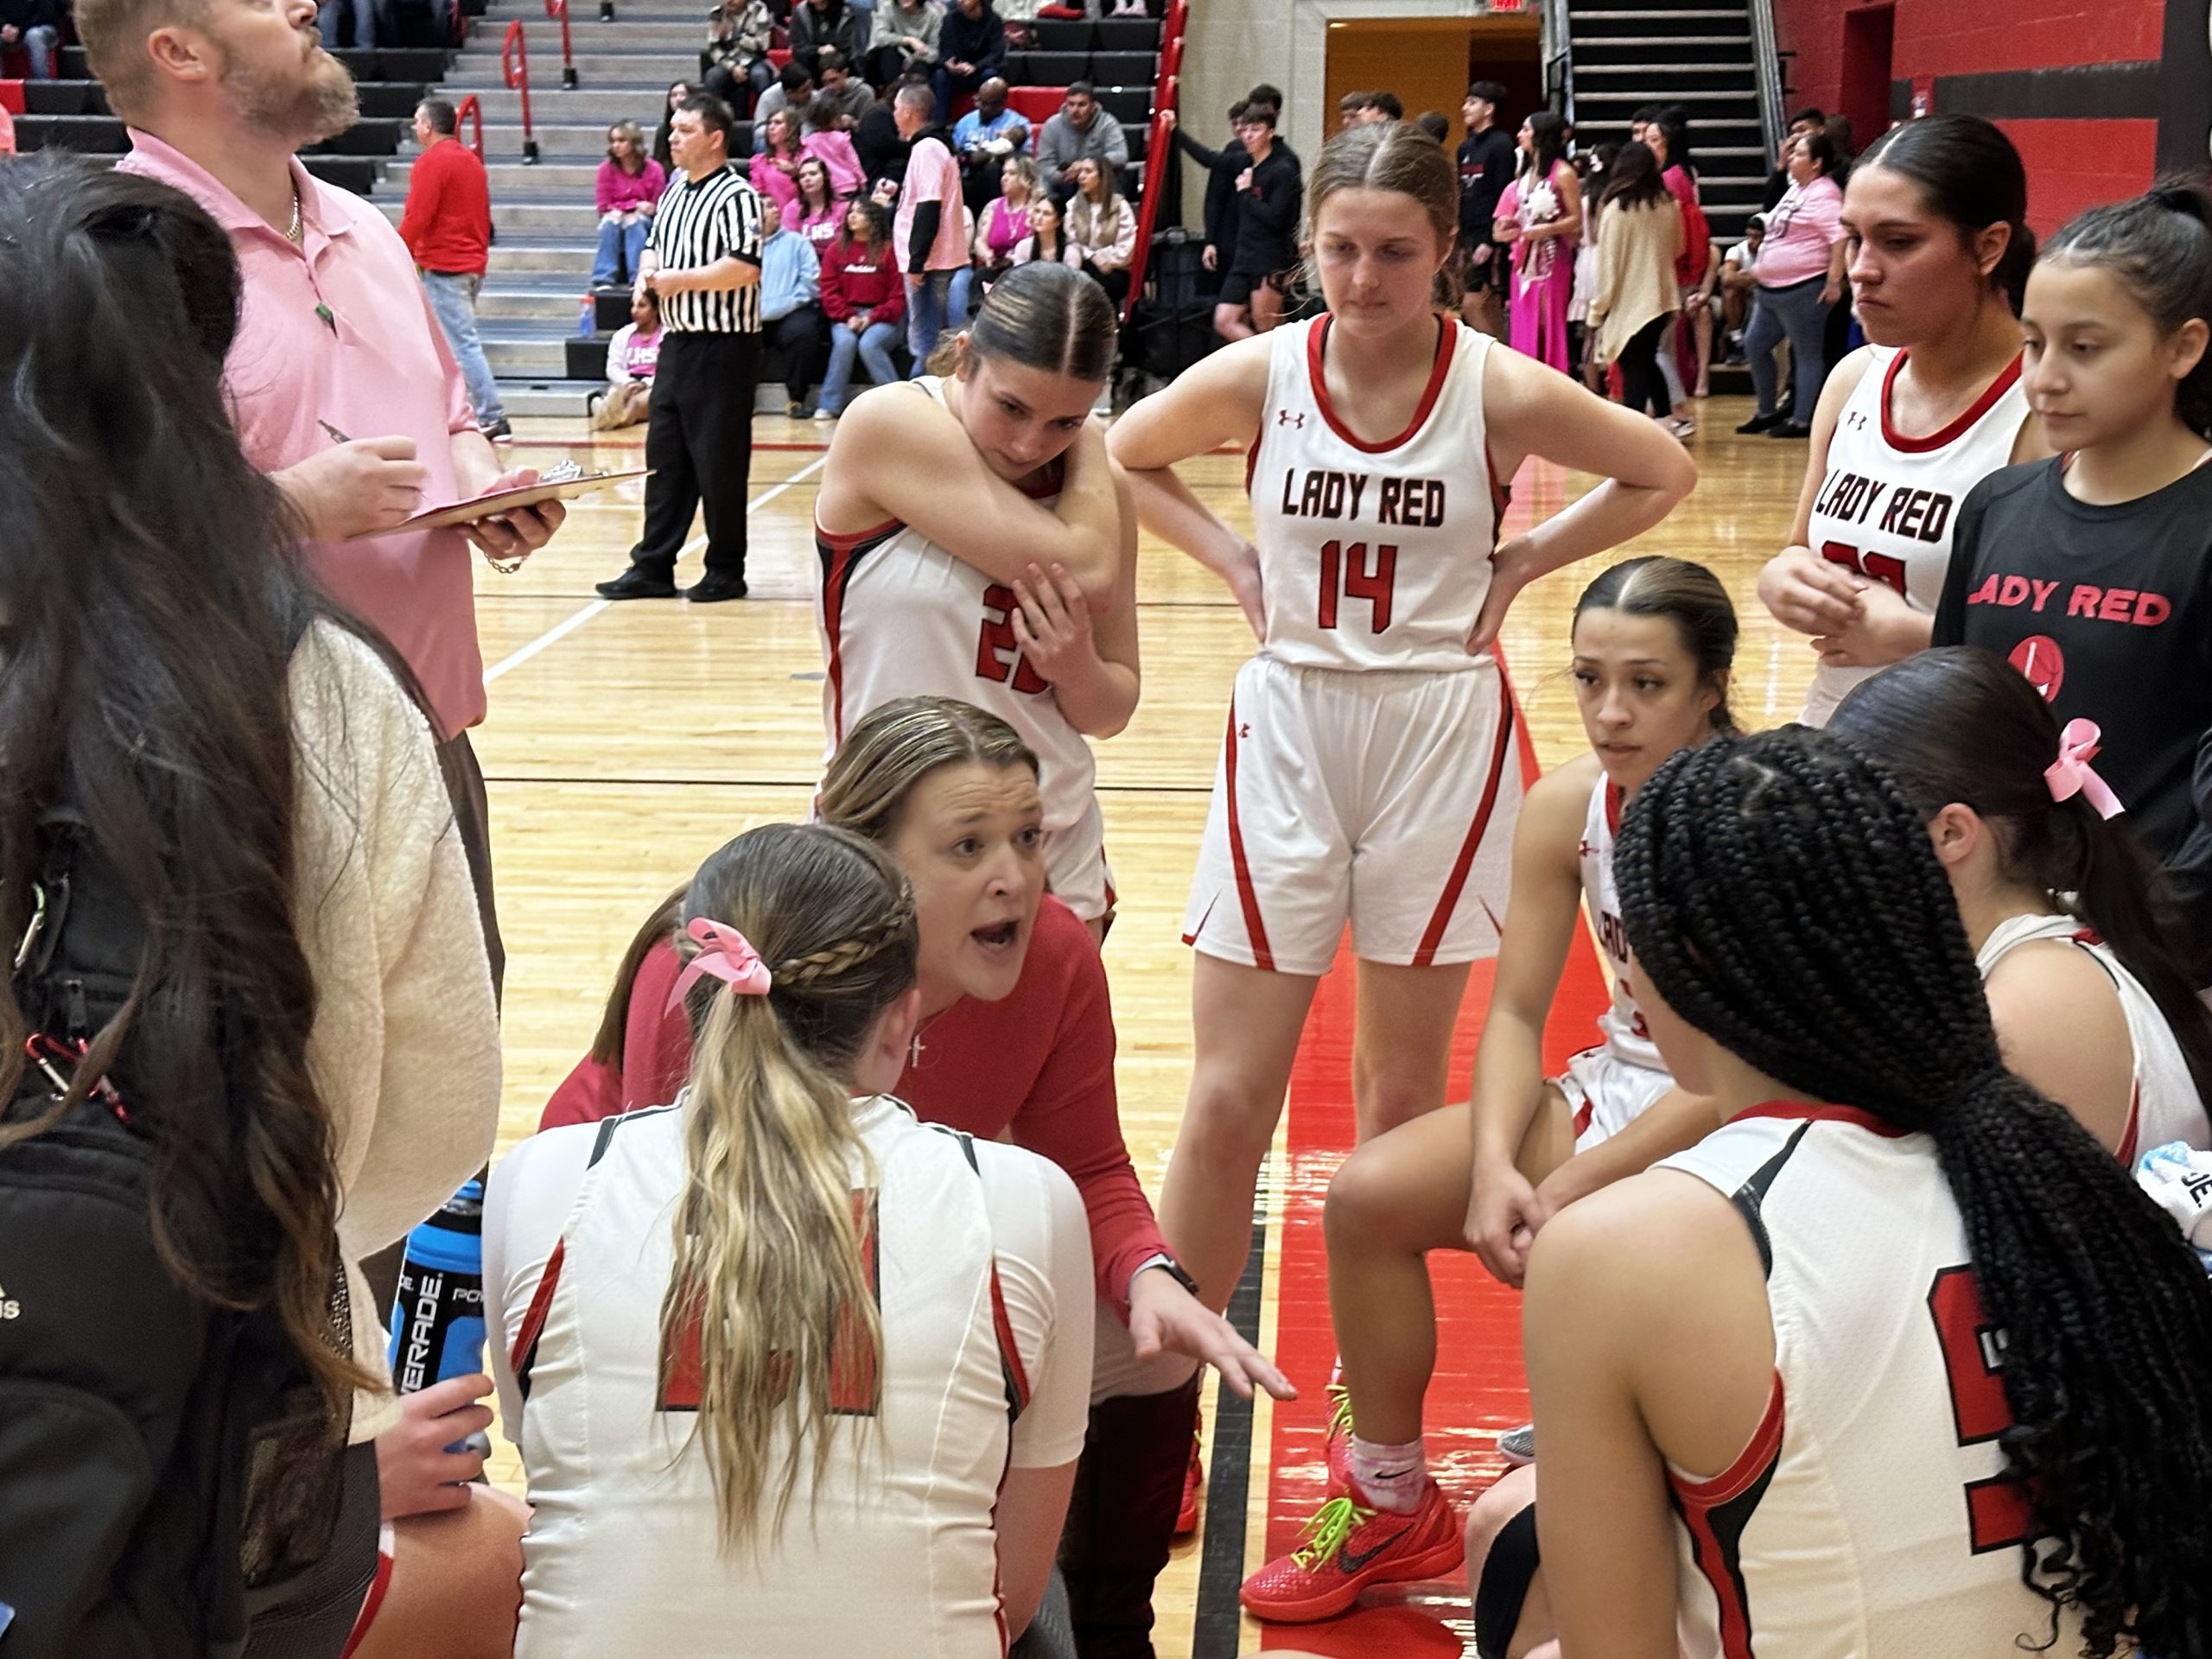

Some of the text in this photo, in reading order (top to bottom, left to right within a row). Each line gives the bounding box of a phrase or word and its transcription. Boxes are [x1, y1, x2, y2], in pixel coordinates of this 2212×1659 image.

[802, 221, 835, 241] LHS
[1282, 467, 1446, 528] LADY RED
[1815, 468, 1954, 544] LADY RED
[1319, 539, 1399, 634] 14
[2067, 584, 2172, 627] RED
